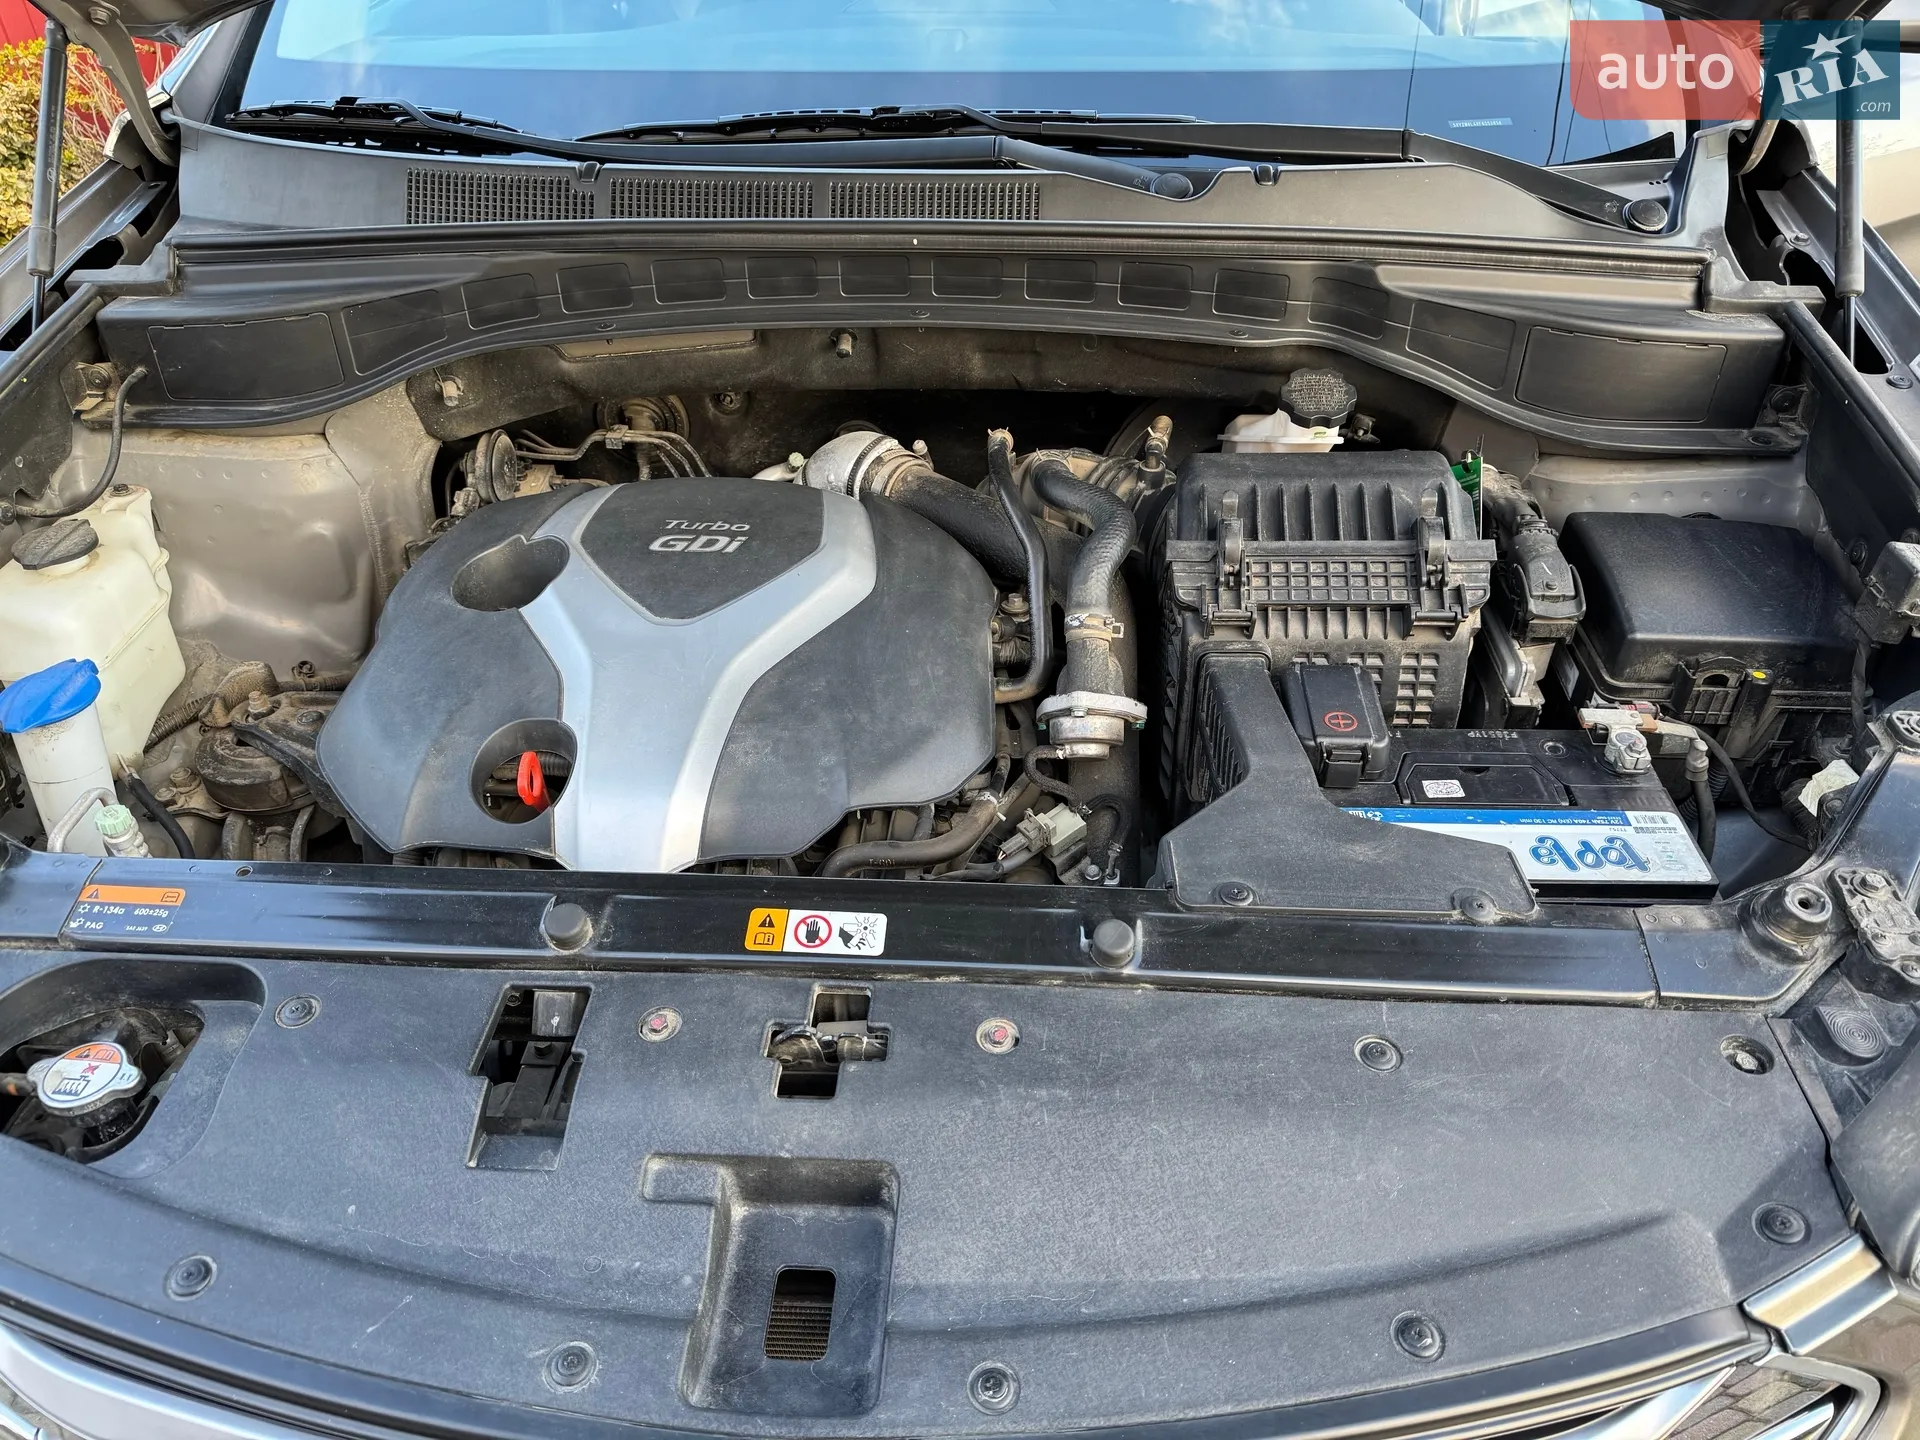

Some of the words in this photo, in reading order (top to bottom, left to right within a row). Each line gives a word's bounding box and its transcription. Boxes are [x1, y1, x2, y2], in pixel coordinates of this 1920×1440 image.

[665, 519, 751, 531] Turbo
[648, 534, 749, 554] GDi
[1528, 834, 1651, 874] topla
[92, 905, 126, 915] R-134a
[133, 907, 169, 918] 600±25g
[84, 920, 104, 930] PAG
